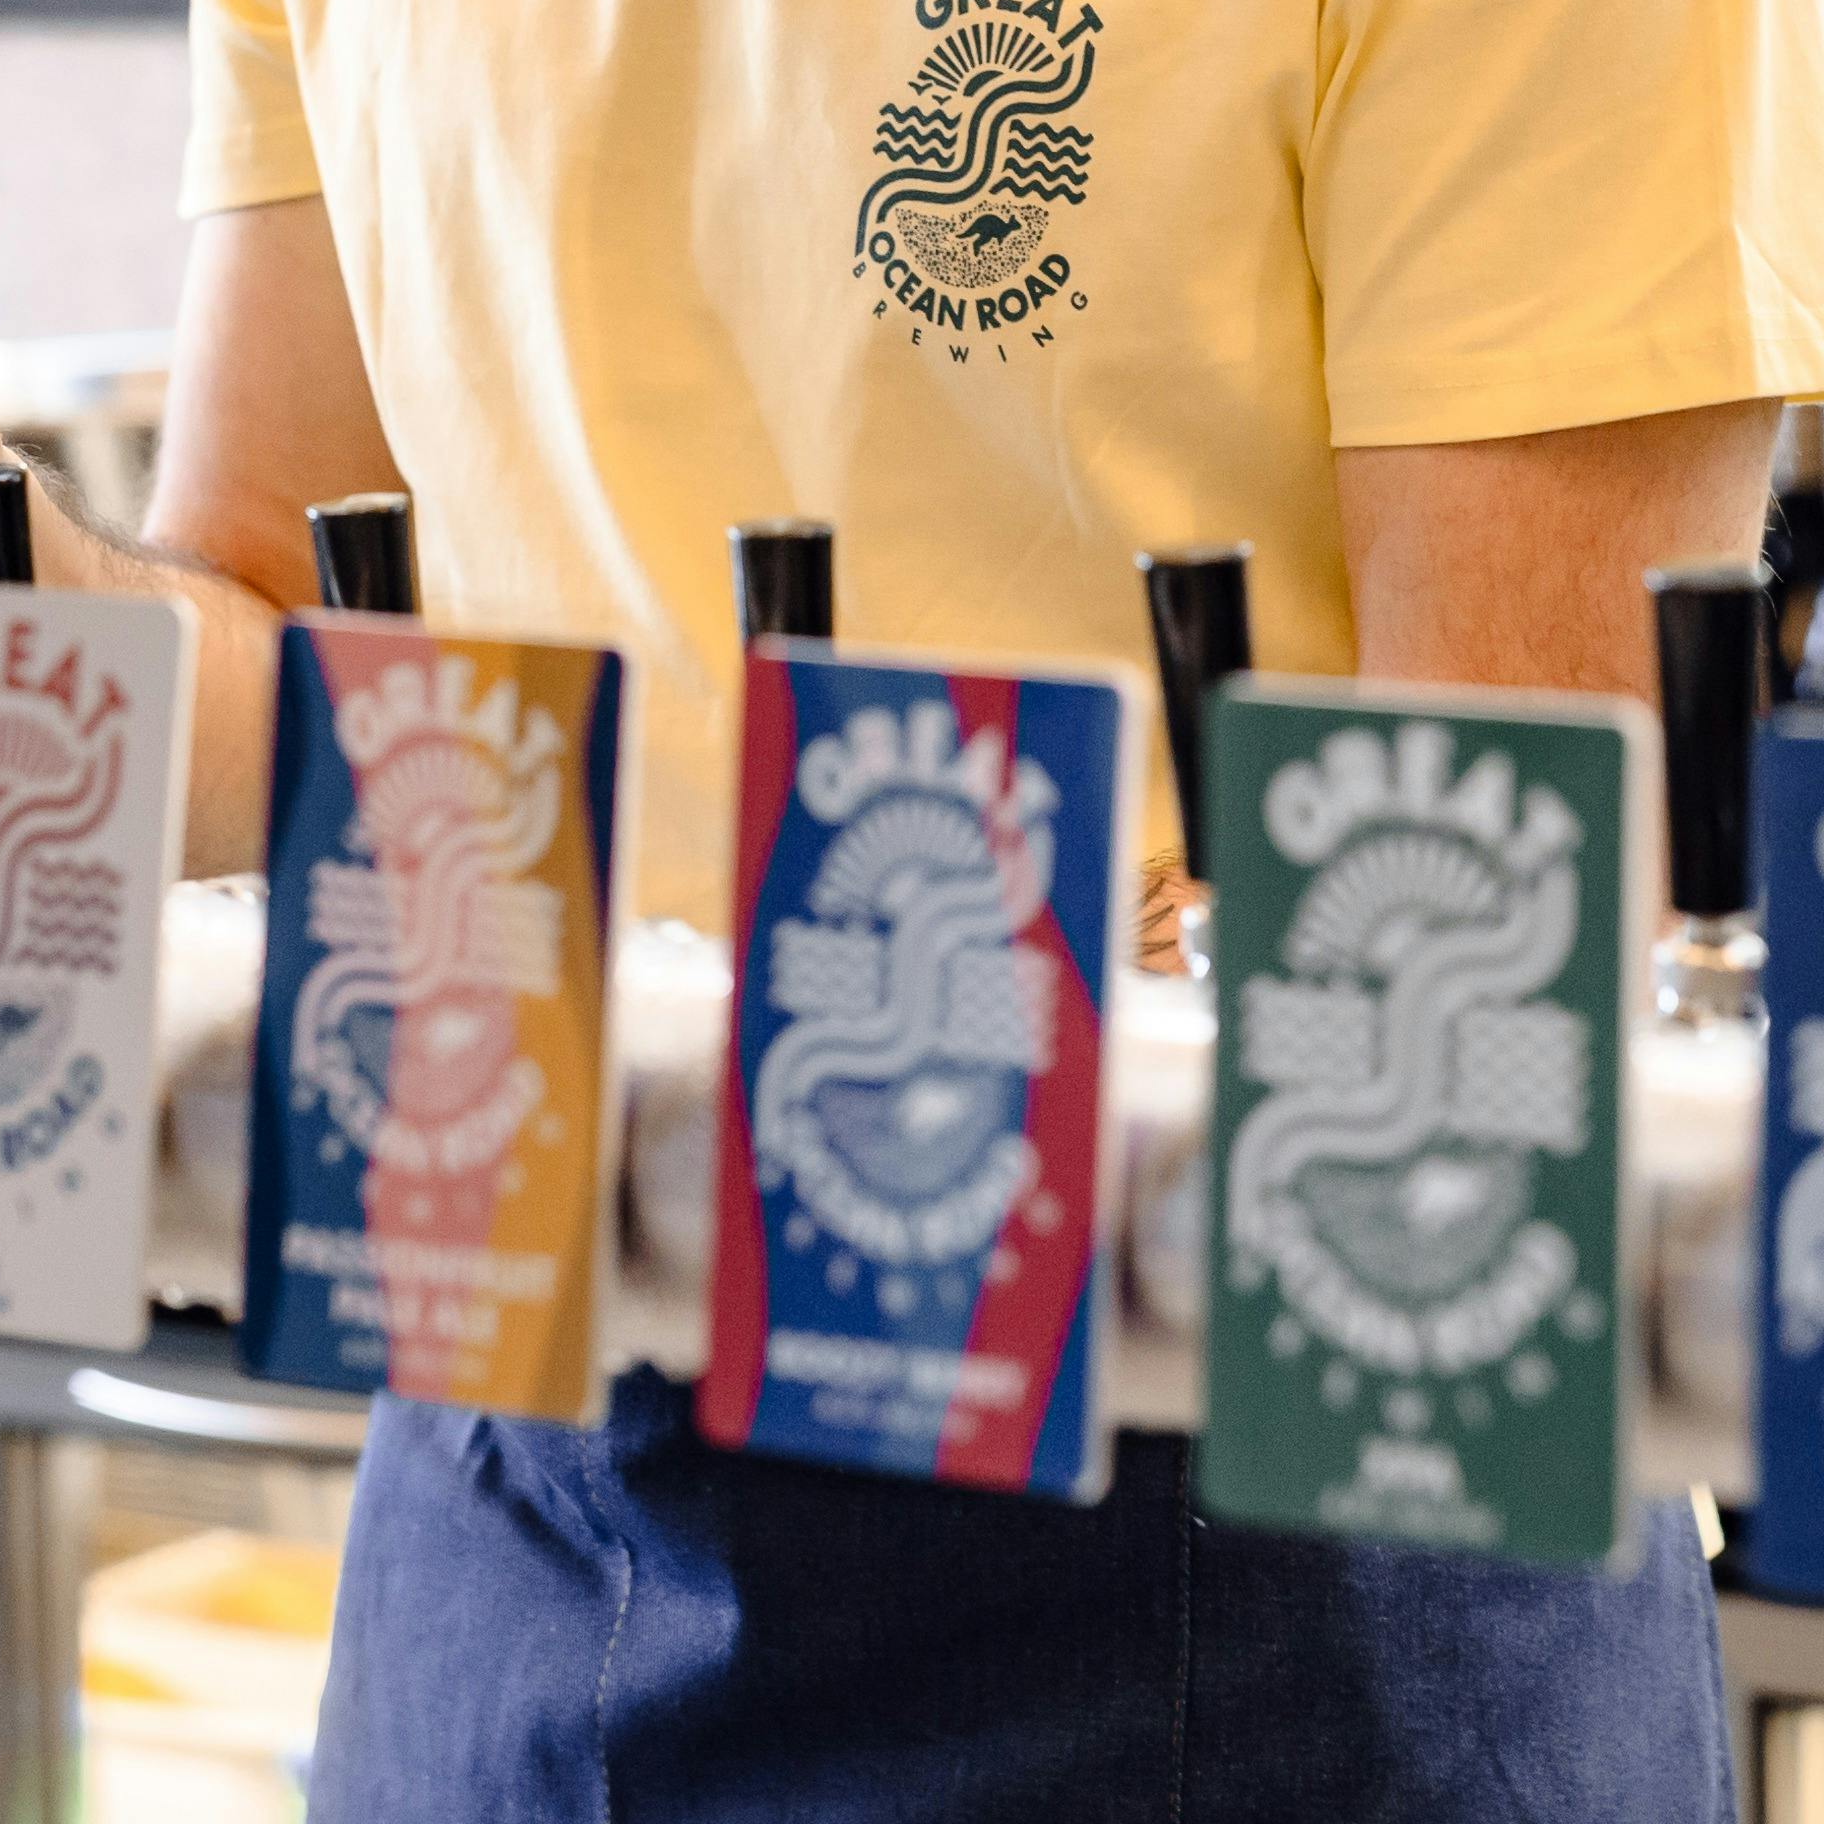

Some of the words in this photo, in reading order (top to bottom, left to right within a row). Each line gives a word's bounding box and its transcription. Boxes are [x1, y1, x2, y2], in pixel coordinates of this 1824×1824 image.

[852, 261, 1088, 363] BREWING
[869, 231, 967, 330] OCEAN
[976, 253, 1070, 330] ROAD
